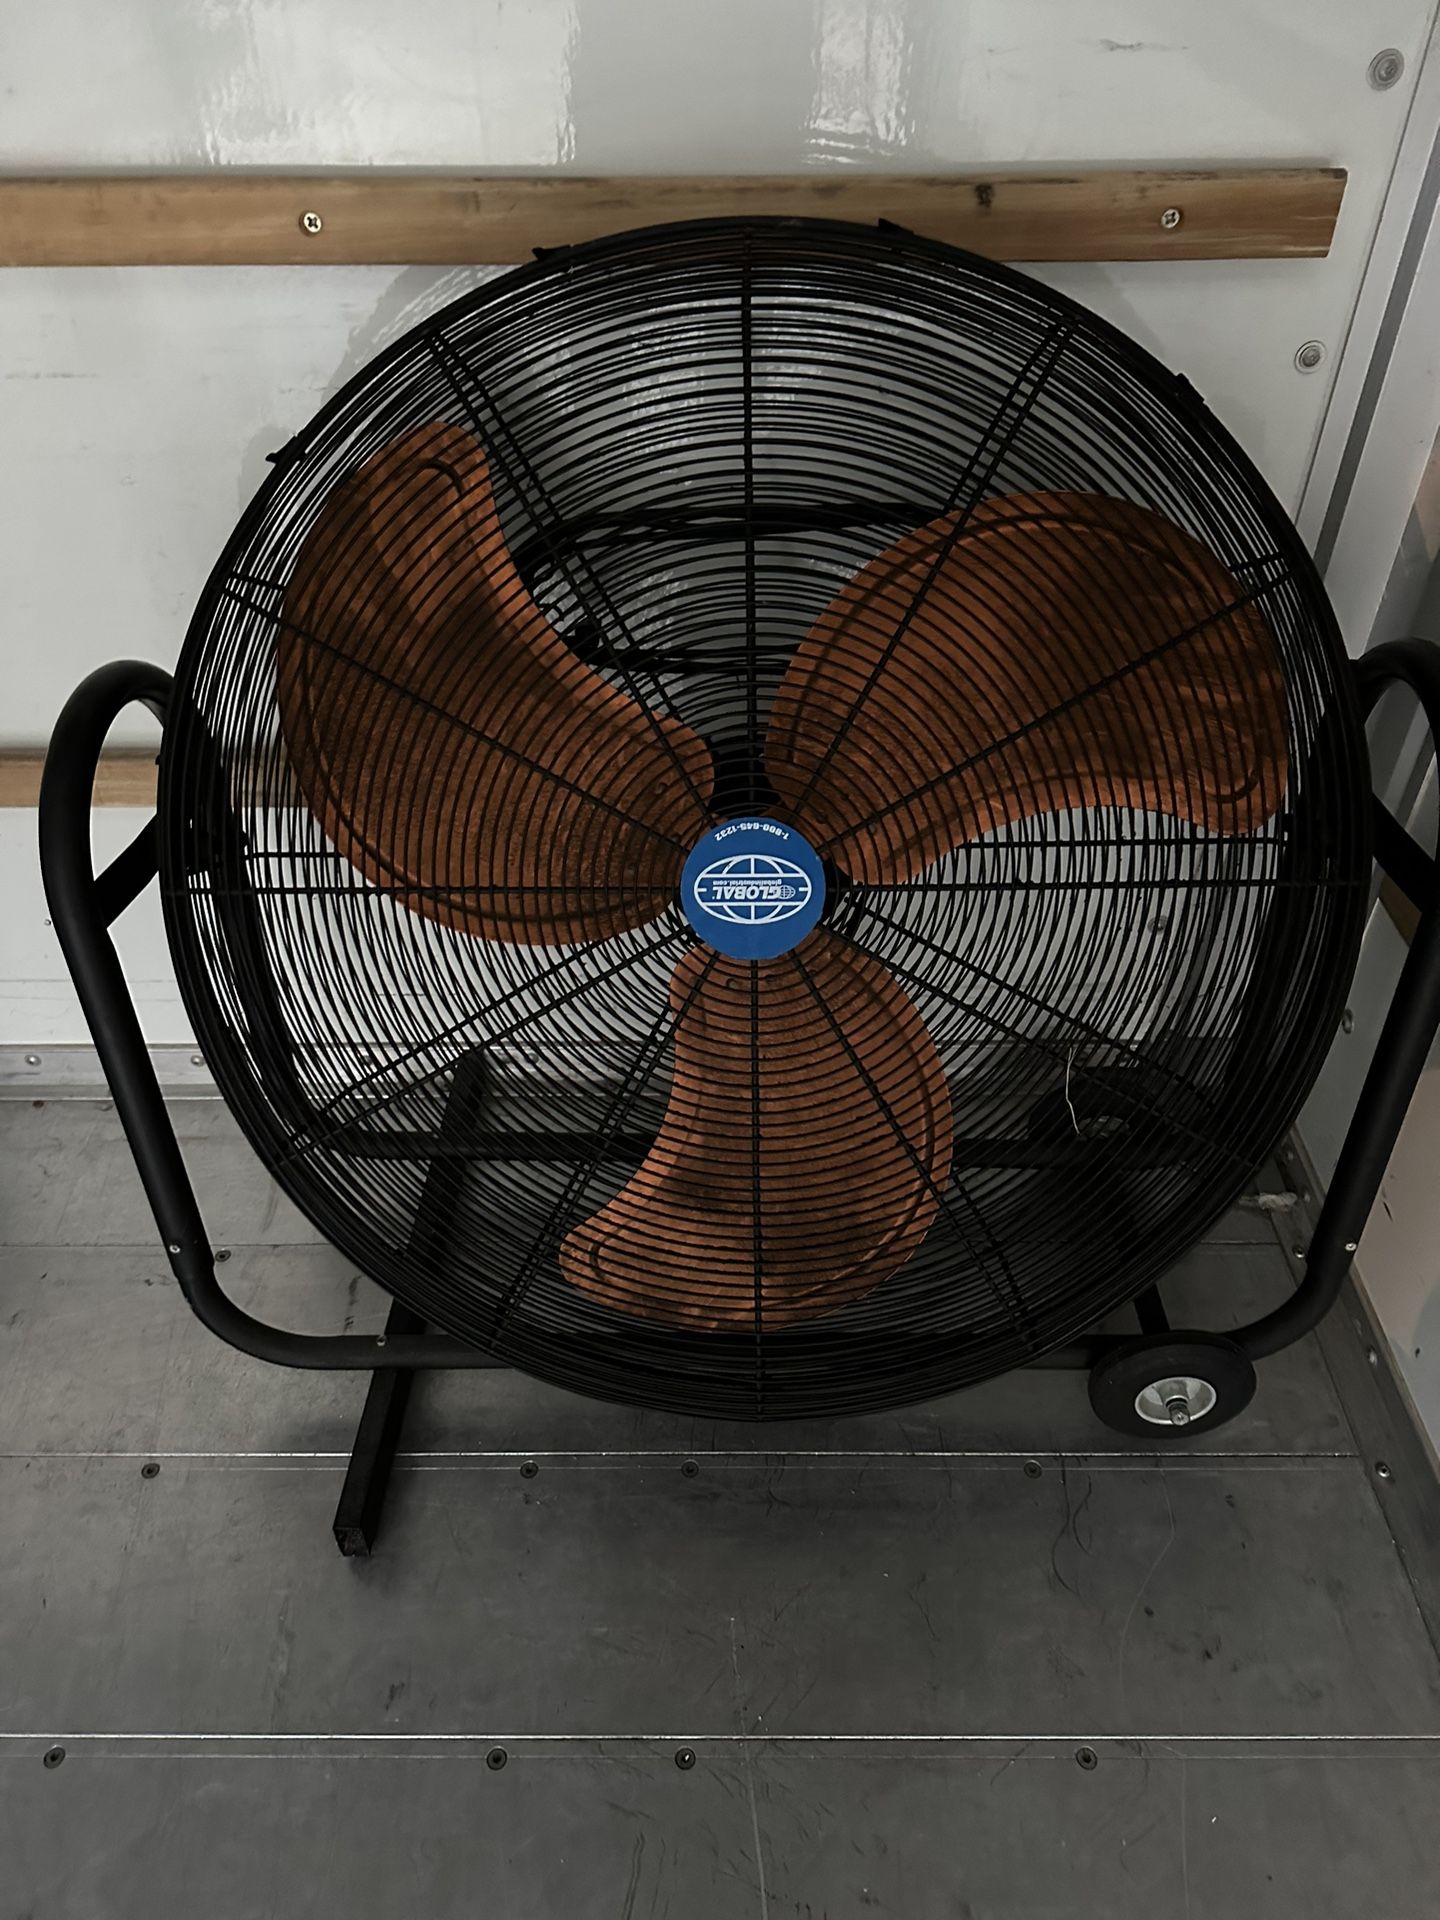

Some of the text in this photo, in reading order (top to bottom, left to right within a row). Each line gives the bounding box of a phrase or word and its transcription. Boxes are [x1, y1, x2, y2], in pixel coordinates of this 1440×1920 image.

[714, 822, 790, 841] 1-800-645-1232
[712, 878, 782, 886] globalindustrial.com
[712, 885, 782, 900] GLOBAL
